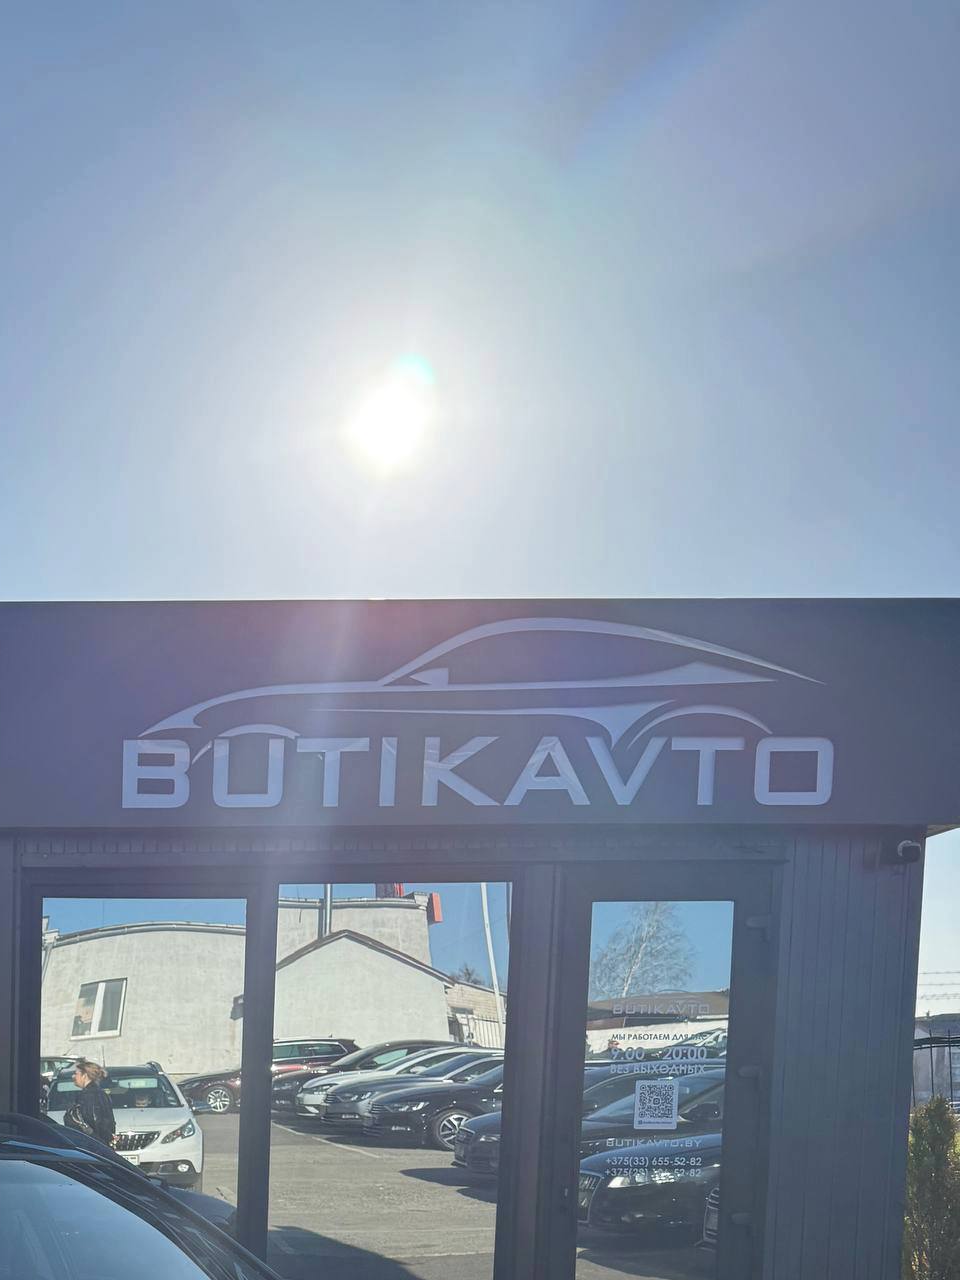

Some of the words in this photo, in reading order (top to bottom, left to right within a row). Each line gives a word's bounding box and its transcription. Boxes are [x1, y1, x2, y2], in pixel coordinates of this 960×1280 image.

[121, 736, 836, 809] BUTIKAVTO
[612, 1004, 711, 1015] BUTIKAVTO
[611, 1033, 626, 1041] МЫ
[627, 1033, 671, 1041] РАБОТАЕМ
[671, 1033, 689, 1041] ДЛЯ
[662, 1046, 708, 1060] 20:00
[633, 1063, 707, 1075] ВЫХОДНЫХ
[606, 1138, 703, 1147] BUTIKAVTO.BY
[606, 1156, 649, 1167] +375(33)
[651, 1156, 703, 1166] 655-52-82
